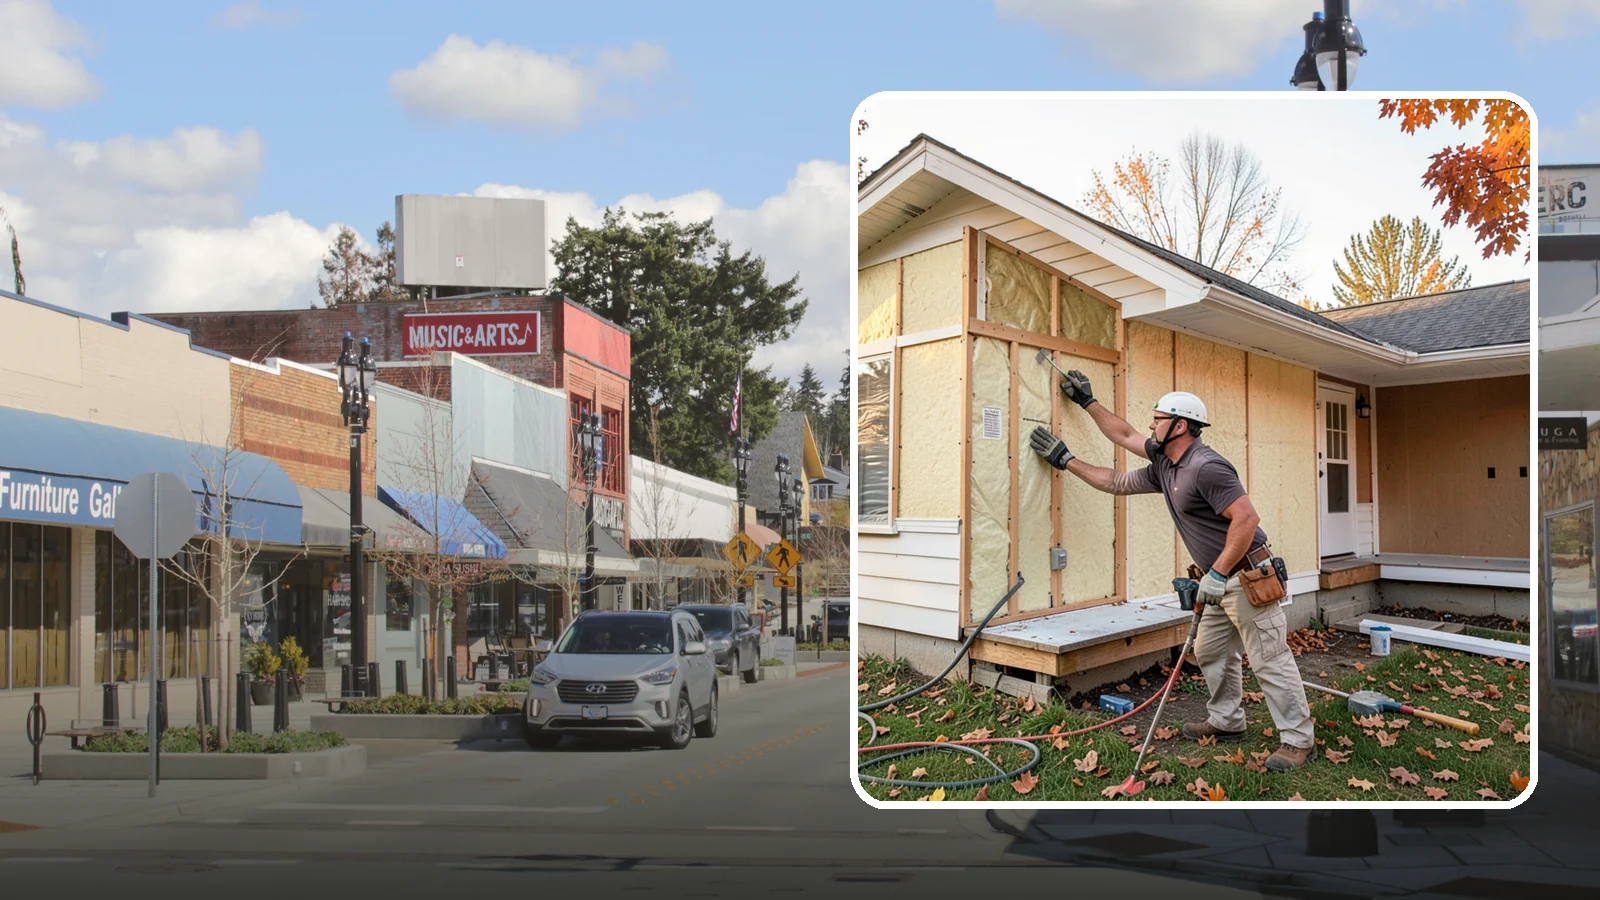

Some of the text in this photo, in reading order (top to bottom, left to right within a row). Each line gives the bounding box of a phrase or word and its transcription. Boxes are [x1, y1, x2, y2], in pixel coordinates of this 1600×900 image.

[0, 471, 122, 519] Furniture Gal
[454, 563, 479, 574] SUSHI
